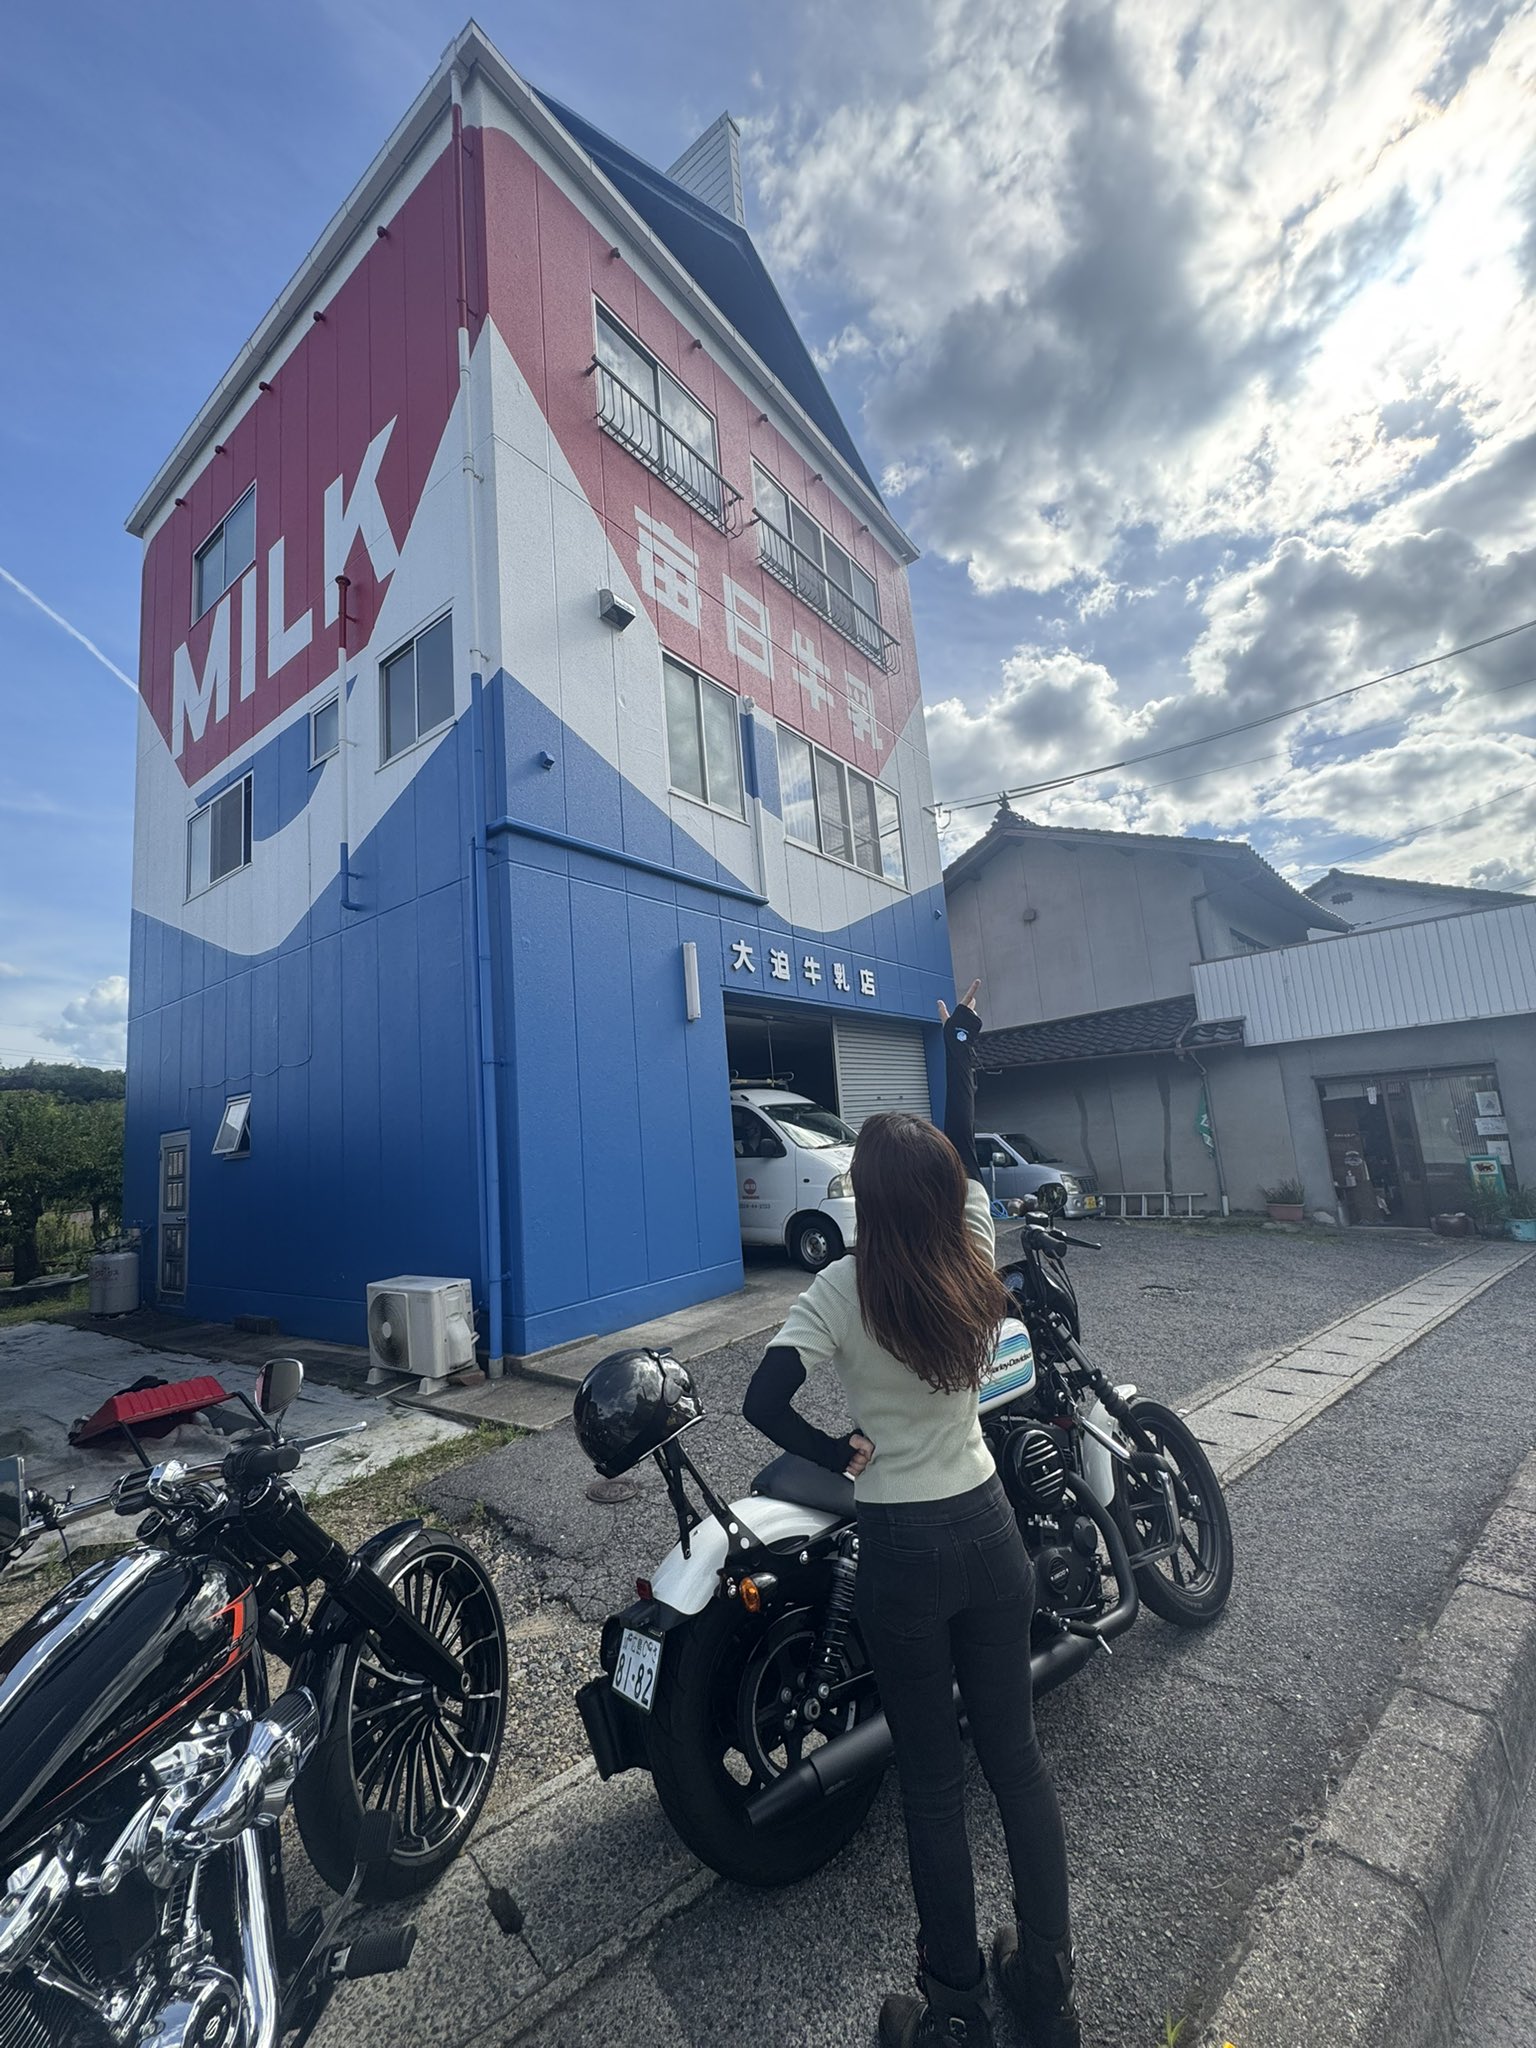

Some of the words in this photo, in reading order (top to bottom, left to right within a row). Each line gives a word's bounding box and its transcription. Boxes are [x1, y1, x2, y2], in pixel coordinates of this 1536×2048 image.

[171, 414, 400, 757] MILK
[634, 505, 883, 750] 毎日牛乳
[731, 938, 876, 997] 大迫牛乳店
